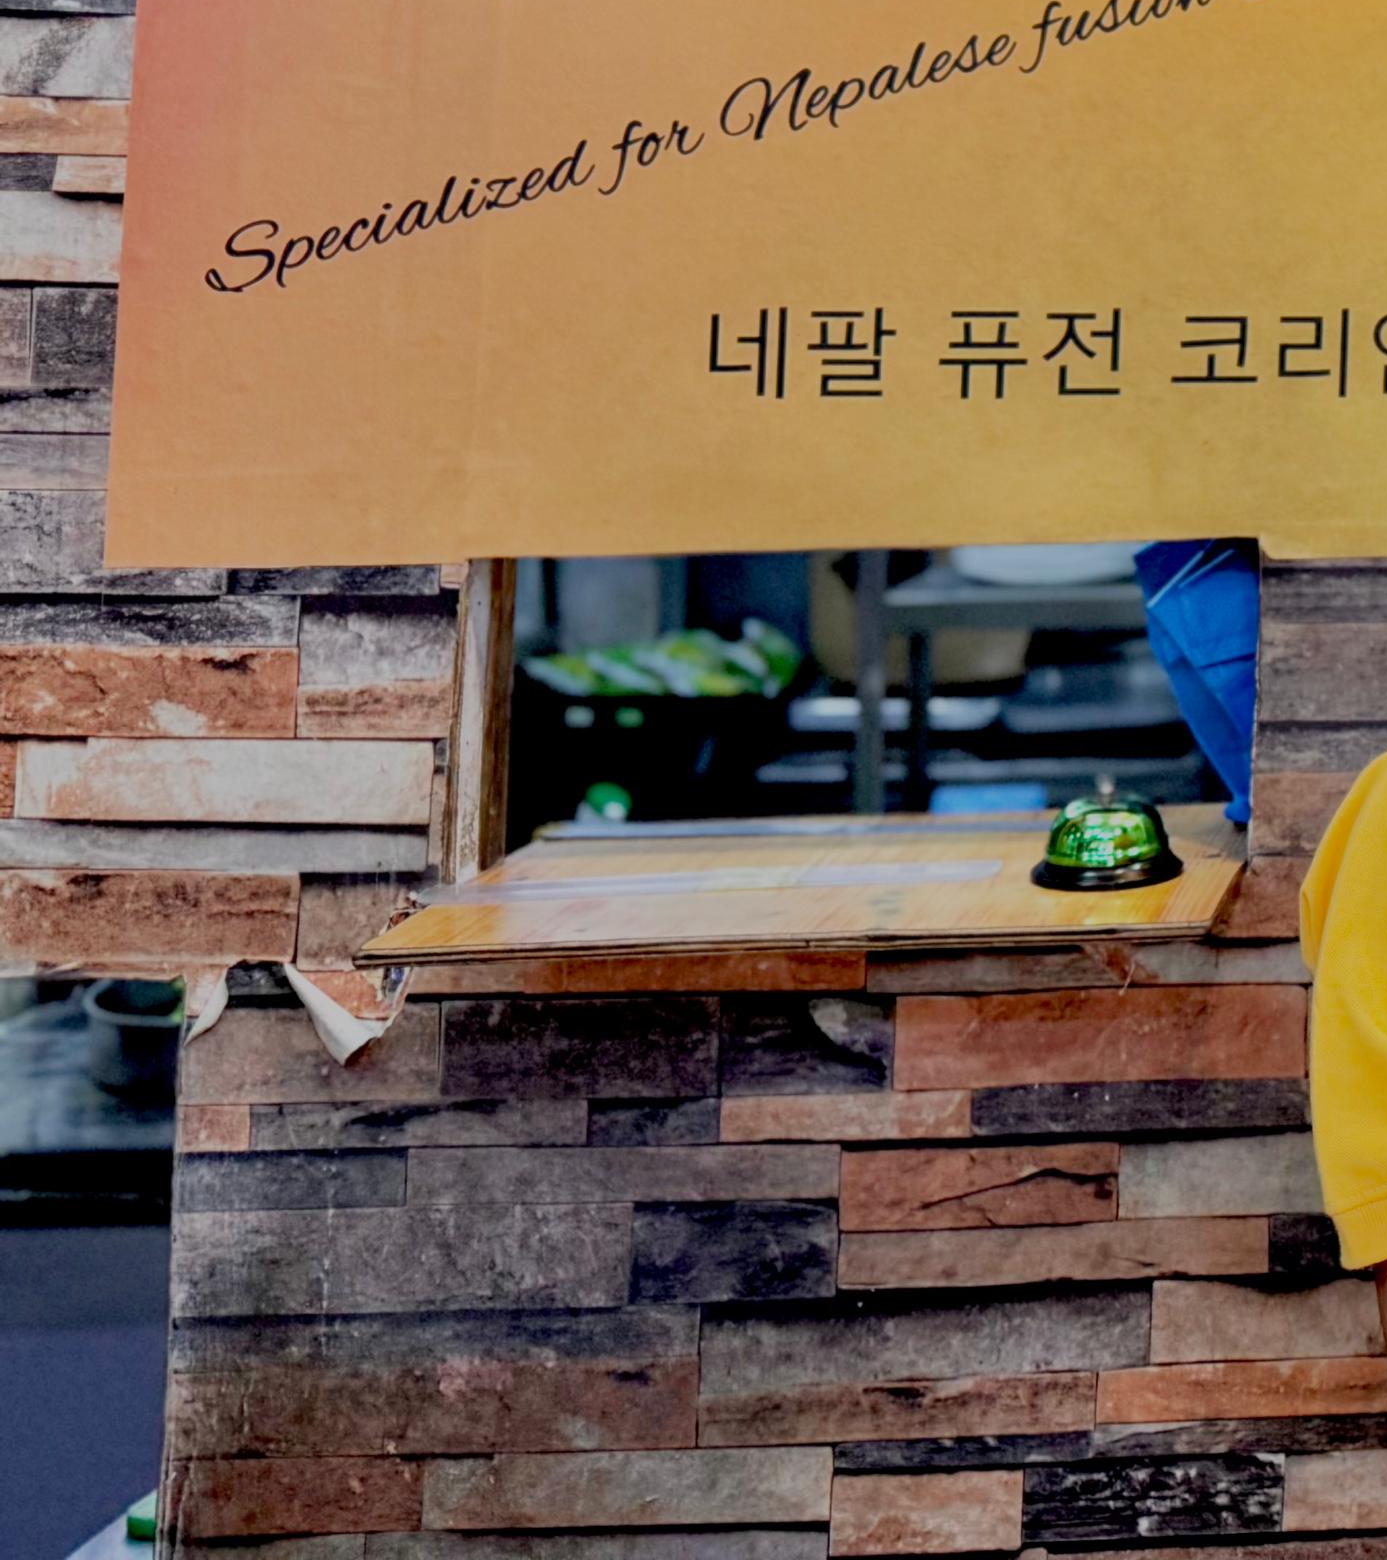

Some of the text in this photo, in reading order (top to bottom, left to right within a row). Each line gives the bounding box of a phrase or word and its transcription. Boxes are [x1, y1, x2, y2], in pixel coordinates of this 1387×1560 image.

[204, 139, 594, 294] Specialized
[598, 120, 704, 196] for
[719, 33, 1017, 142] Nepalese
[708, 306, 898, 400] 네팔
[937, 307, 1122, 400] 퓨전
